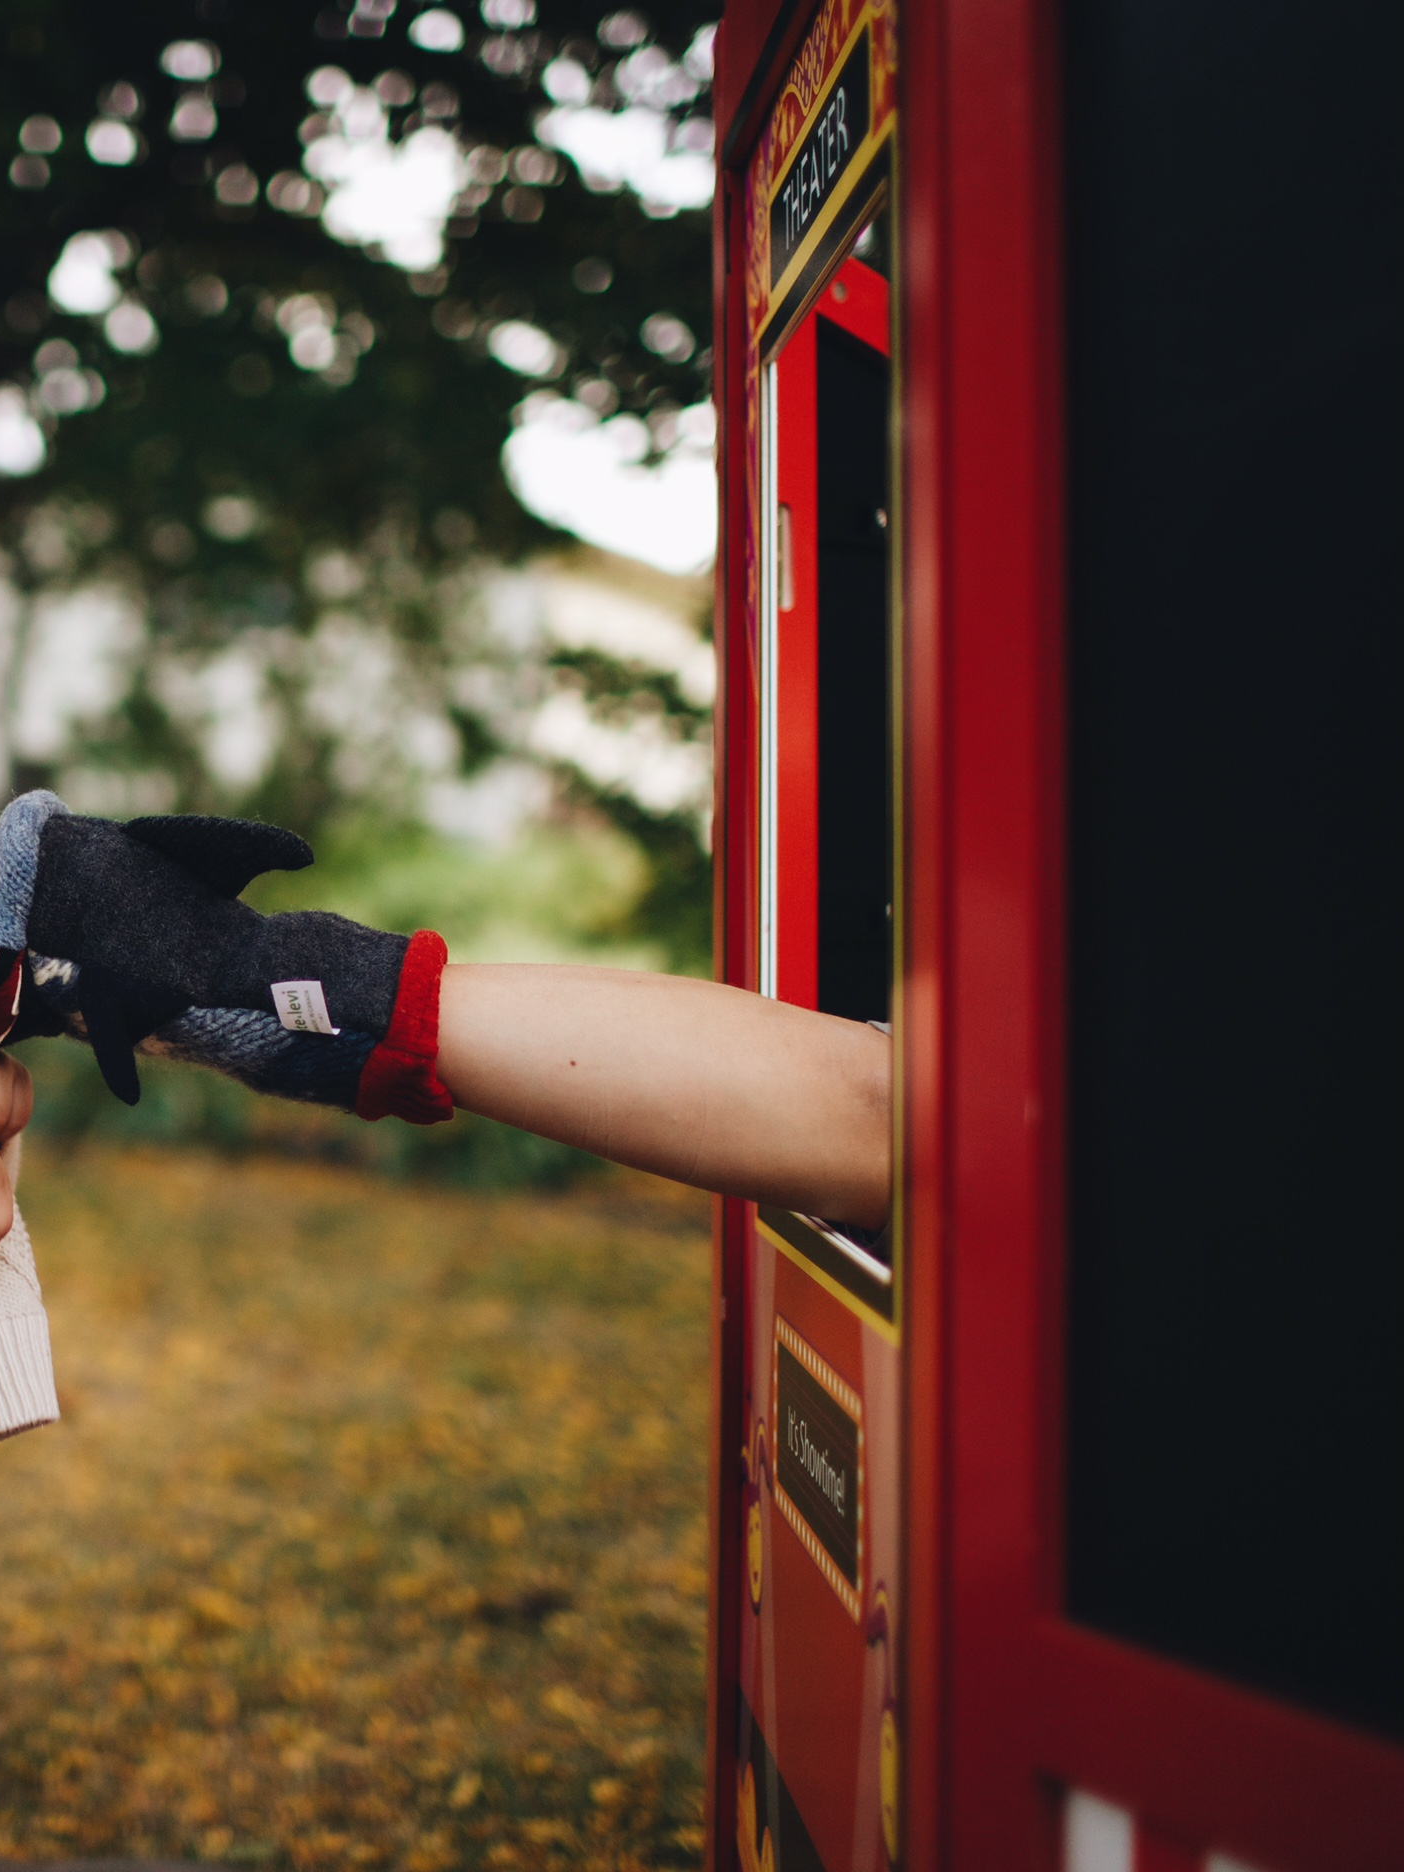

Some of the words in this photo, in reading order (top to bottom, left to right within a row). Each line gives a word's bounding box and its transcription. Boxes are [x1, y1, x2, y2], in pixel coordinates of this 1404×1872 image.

[782, 86, 848, 251] THEATER
[787, 1404, 799, 1457] It's
[799, 1419, 845, 1518] Showtime!
